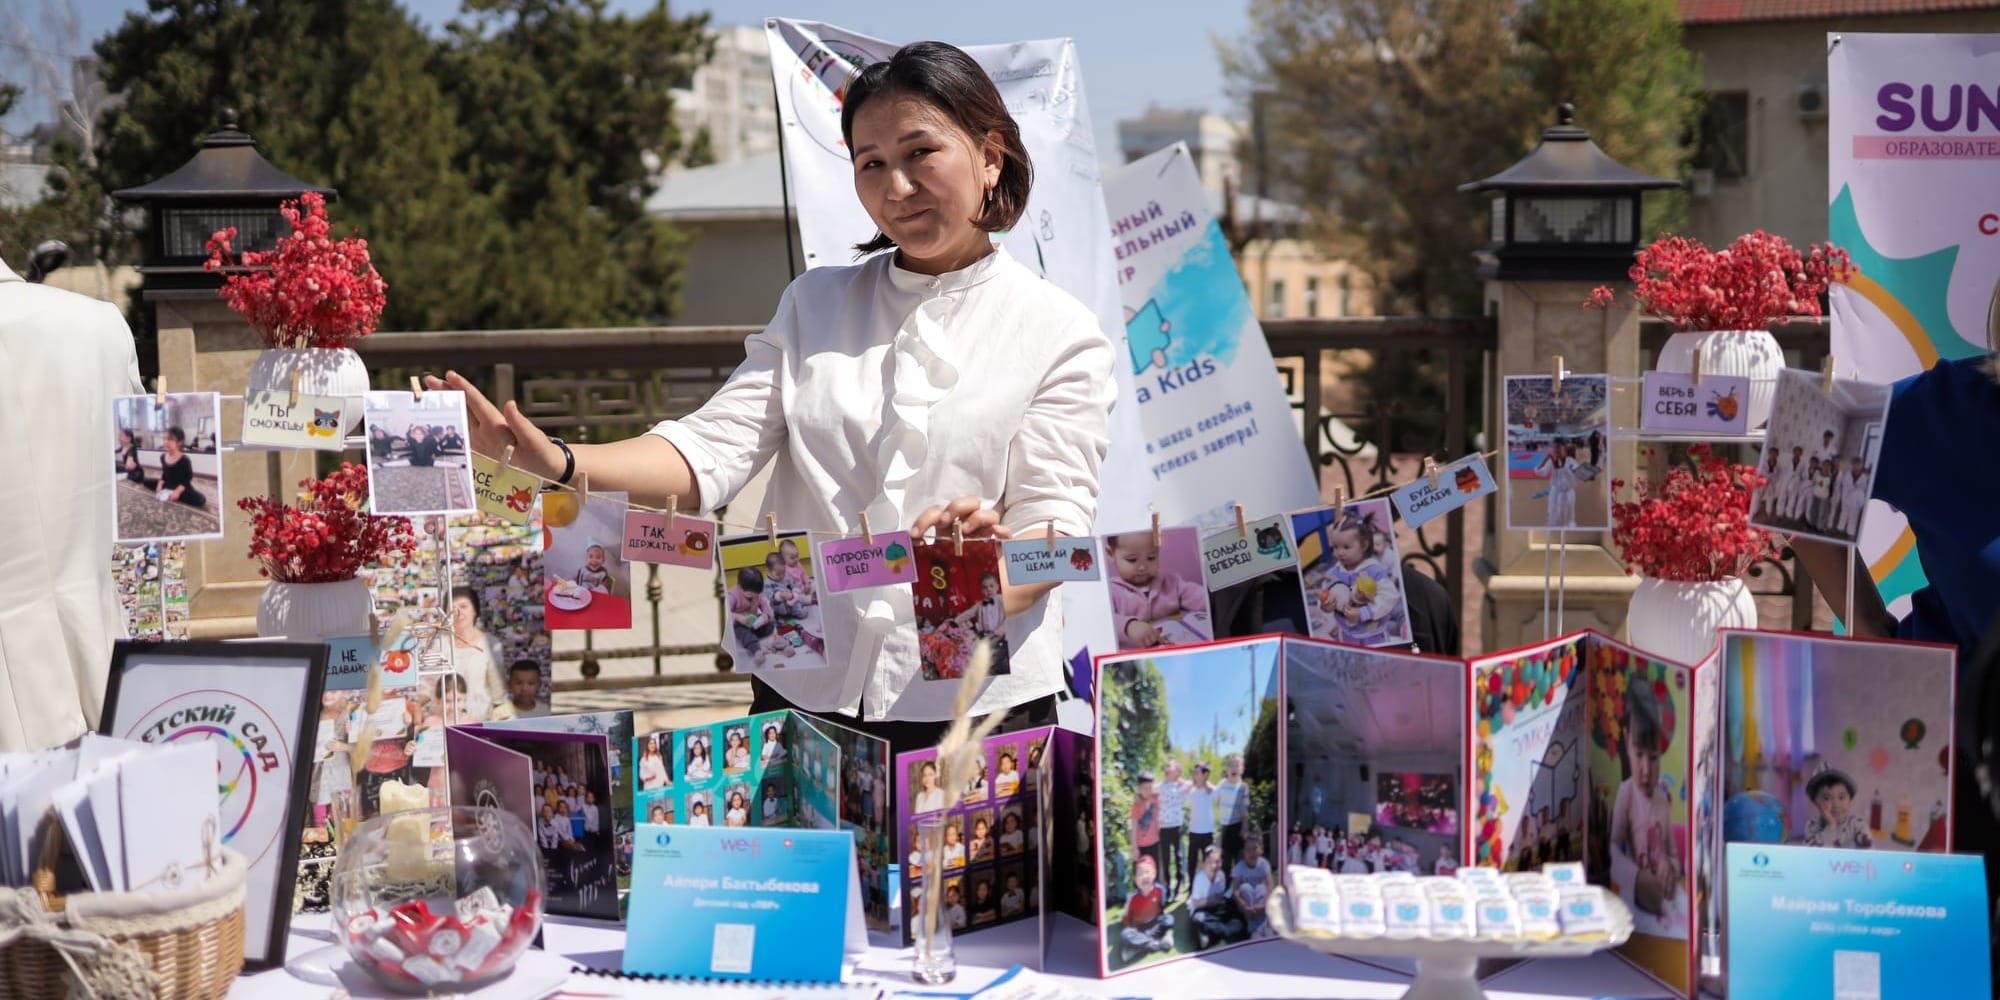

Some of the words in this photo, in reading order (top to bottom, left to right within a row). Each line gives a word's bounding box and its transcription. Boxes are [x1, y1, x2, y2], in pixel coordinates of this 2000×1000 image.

[1158, 358, 1216, 394] Kids
[1659, 386, 1685, 398] ВЕРЬ
[1688, 388, 1695, 398] В
[267, 403, 291, 418] ТЫ
[1196, 400, 1253, 432] сегодня
[1655, 401, 1697, 416] СЕБЯ!
[1151, 449, 1199, 481] успехи
[1203, 418, 1259, 456] завтра!
[1409, 485, 1433, 503] БУД
[640, 524, 665, 540] ТАК
[826, 546, 884, 566] ПОПРОБУЙ
[1011, 549, 1067, 563] ДОСТИАЙ
[1204, 539, 1249, 562] ТОЛЬКО
[341, 649, 358, 662] НЕ
[326, 663, 373, 676] ДАВАЙС
[137, 704, 237, 744] ЕТСКИЙ
[241, 721, 280, 773] САД
